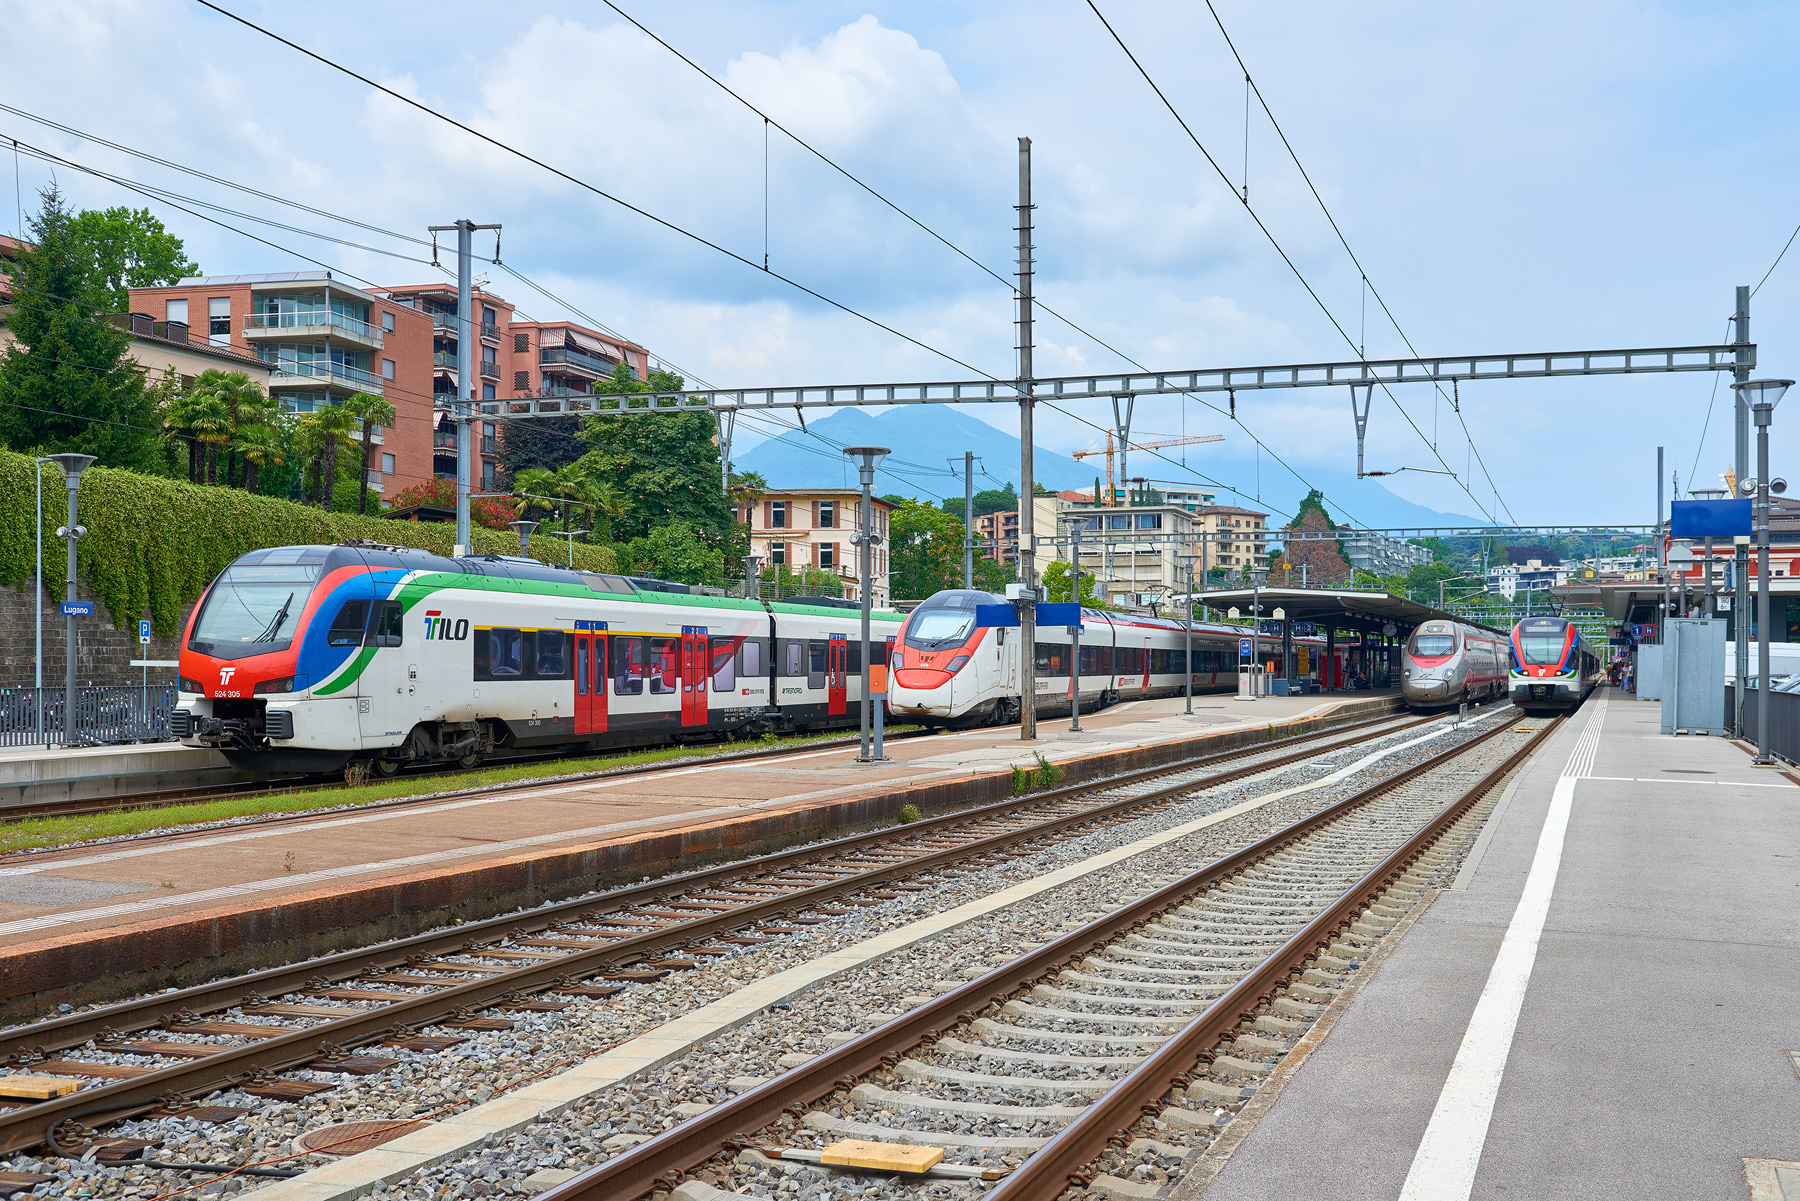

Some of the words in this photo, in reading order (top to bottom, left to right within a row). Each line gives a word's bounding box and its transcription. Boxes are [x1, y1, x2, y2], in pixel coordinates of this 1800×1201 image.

[64, 605, 88, 615] Lugano
[143, 624, 147, 635] P
[424, 610, 469, 640] TILO
